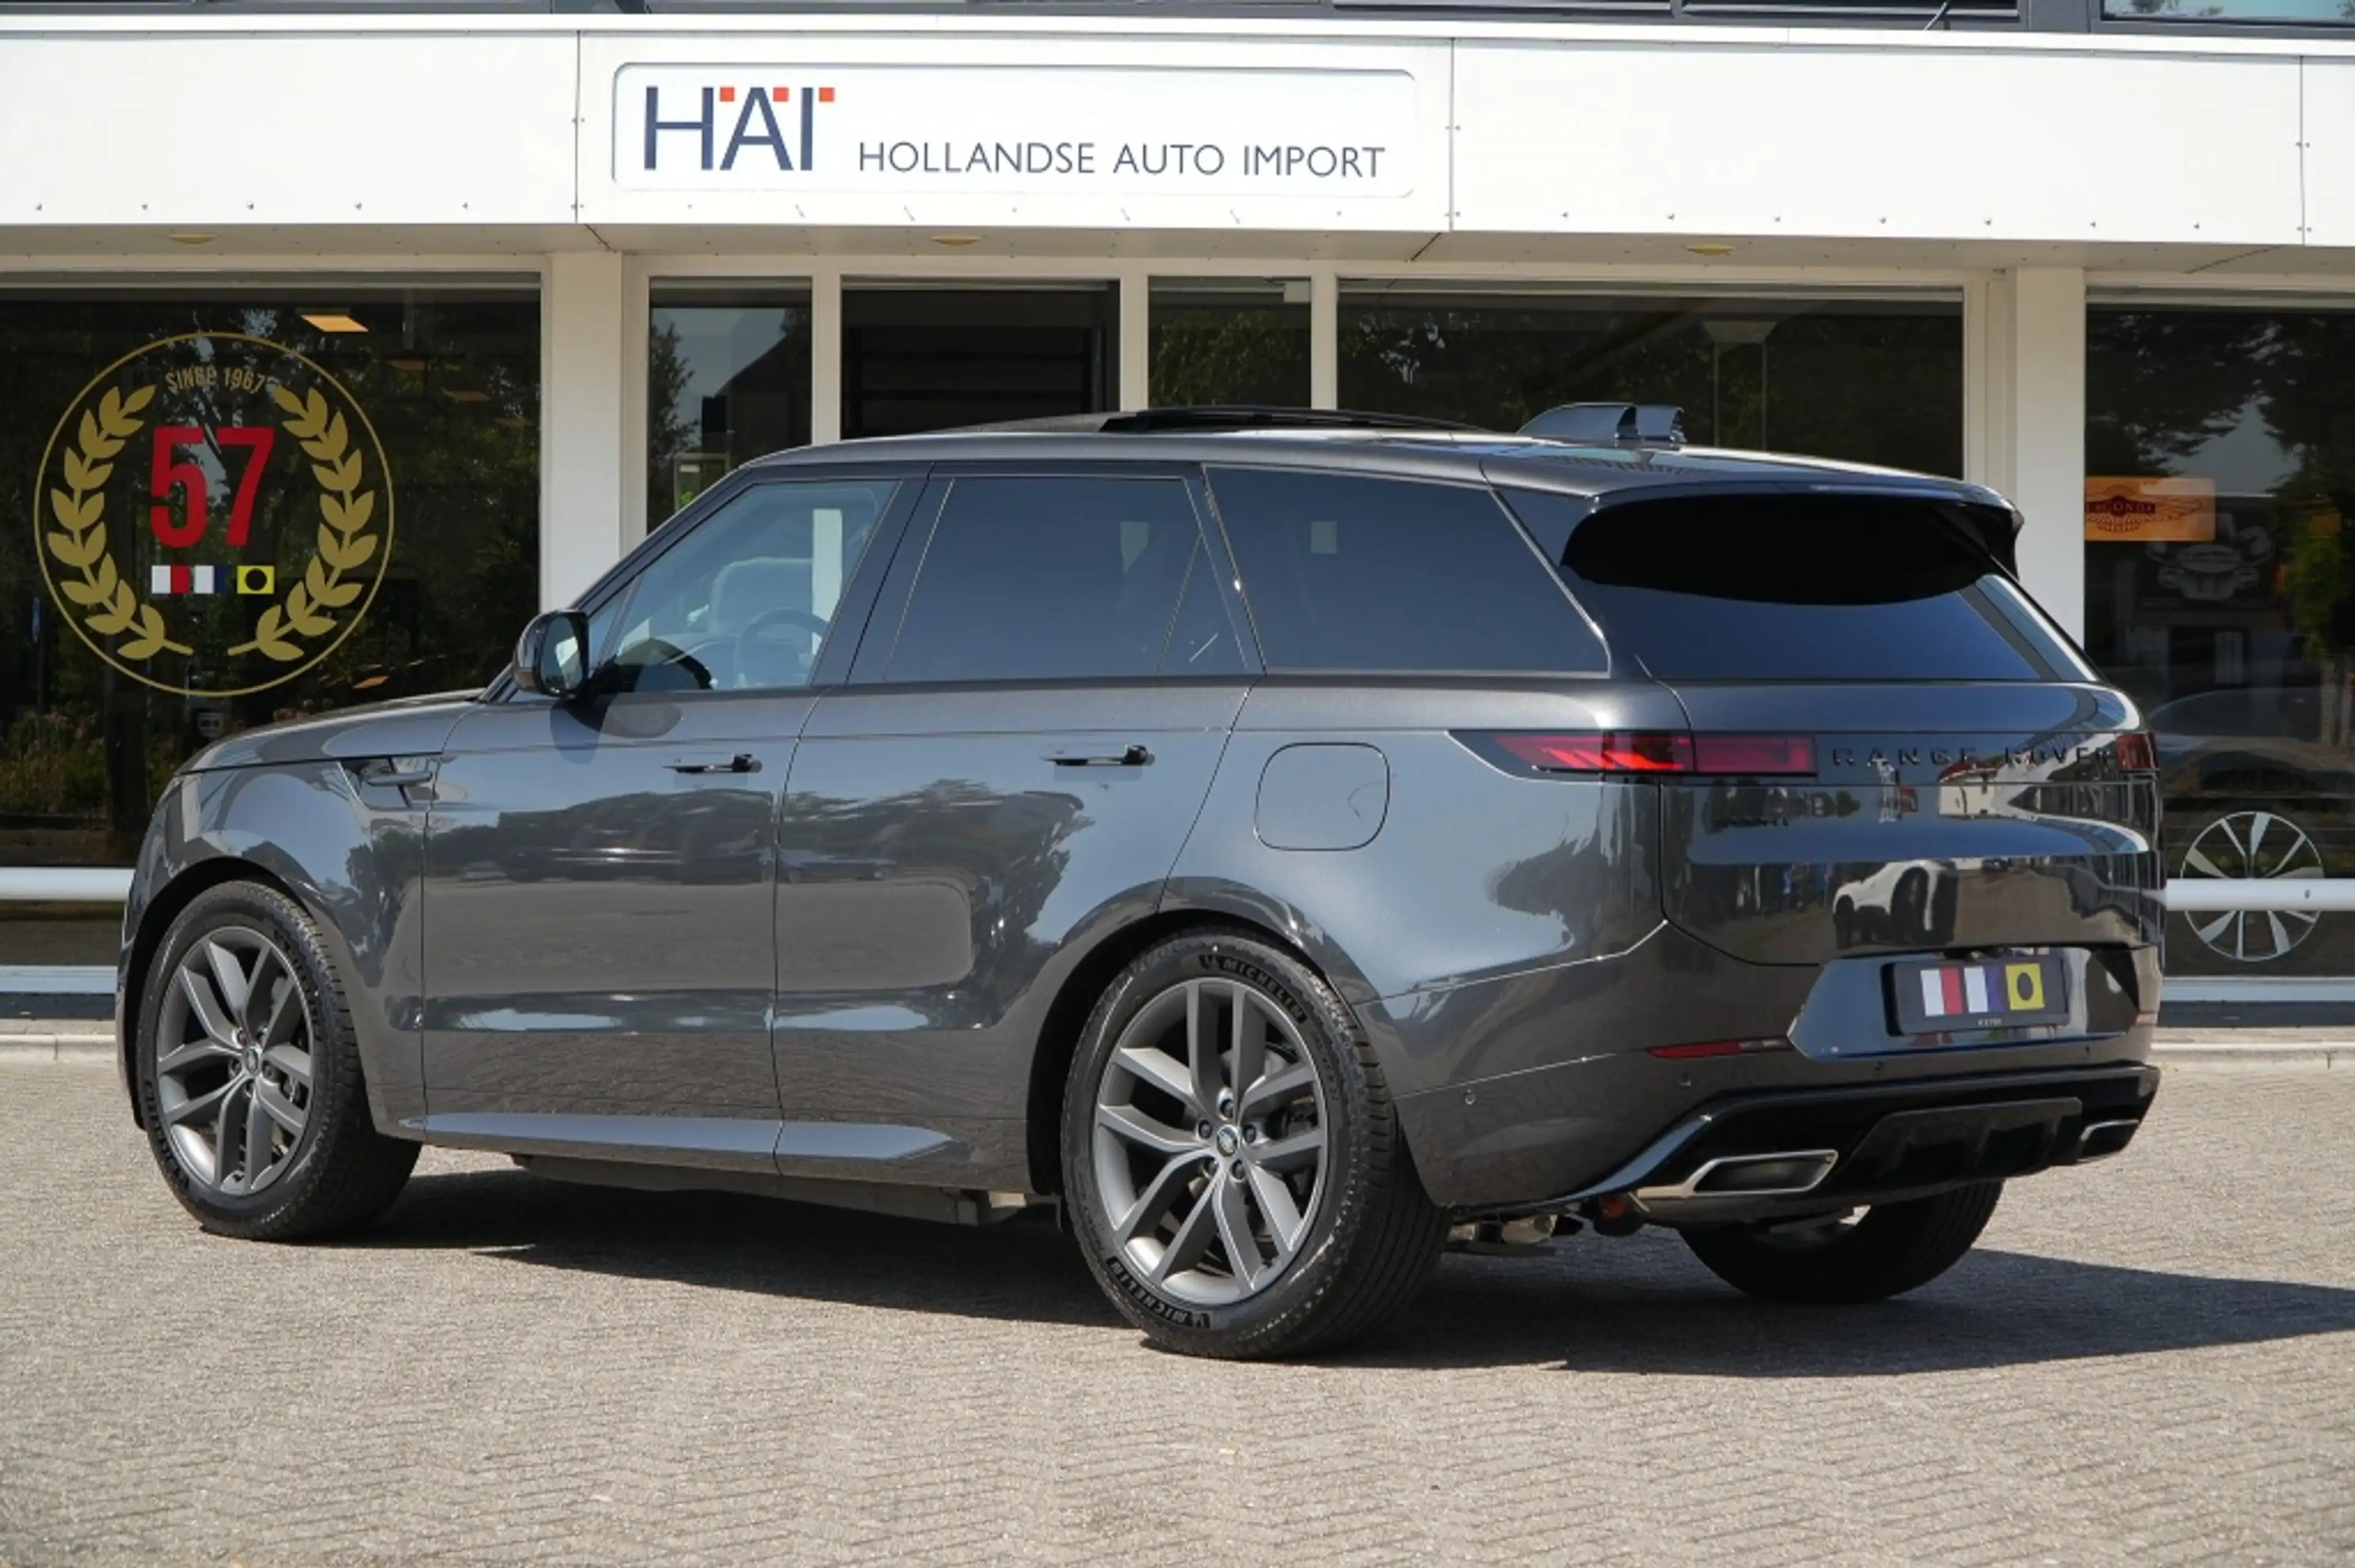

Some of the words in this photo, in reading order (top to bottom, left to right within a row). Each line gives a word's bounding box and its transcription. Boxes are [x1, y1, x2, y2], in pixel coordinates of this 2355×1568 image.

[860, 142, 1095, 174] HOLLANDSE
[1112, 144, 1224, 175] AUTO
[1244, 145, 1385, 177] IMPORT
[165, 365, 216, 396] SINCE
[223, 367, 266, 394] 1967
[151, 426, 274, 547] 57
[1832, 748, 1977, 767] RANGE
[1222, 958, 1305, 1020] MICHELIN
